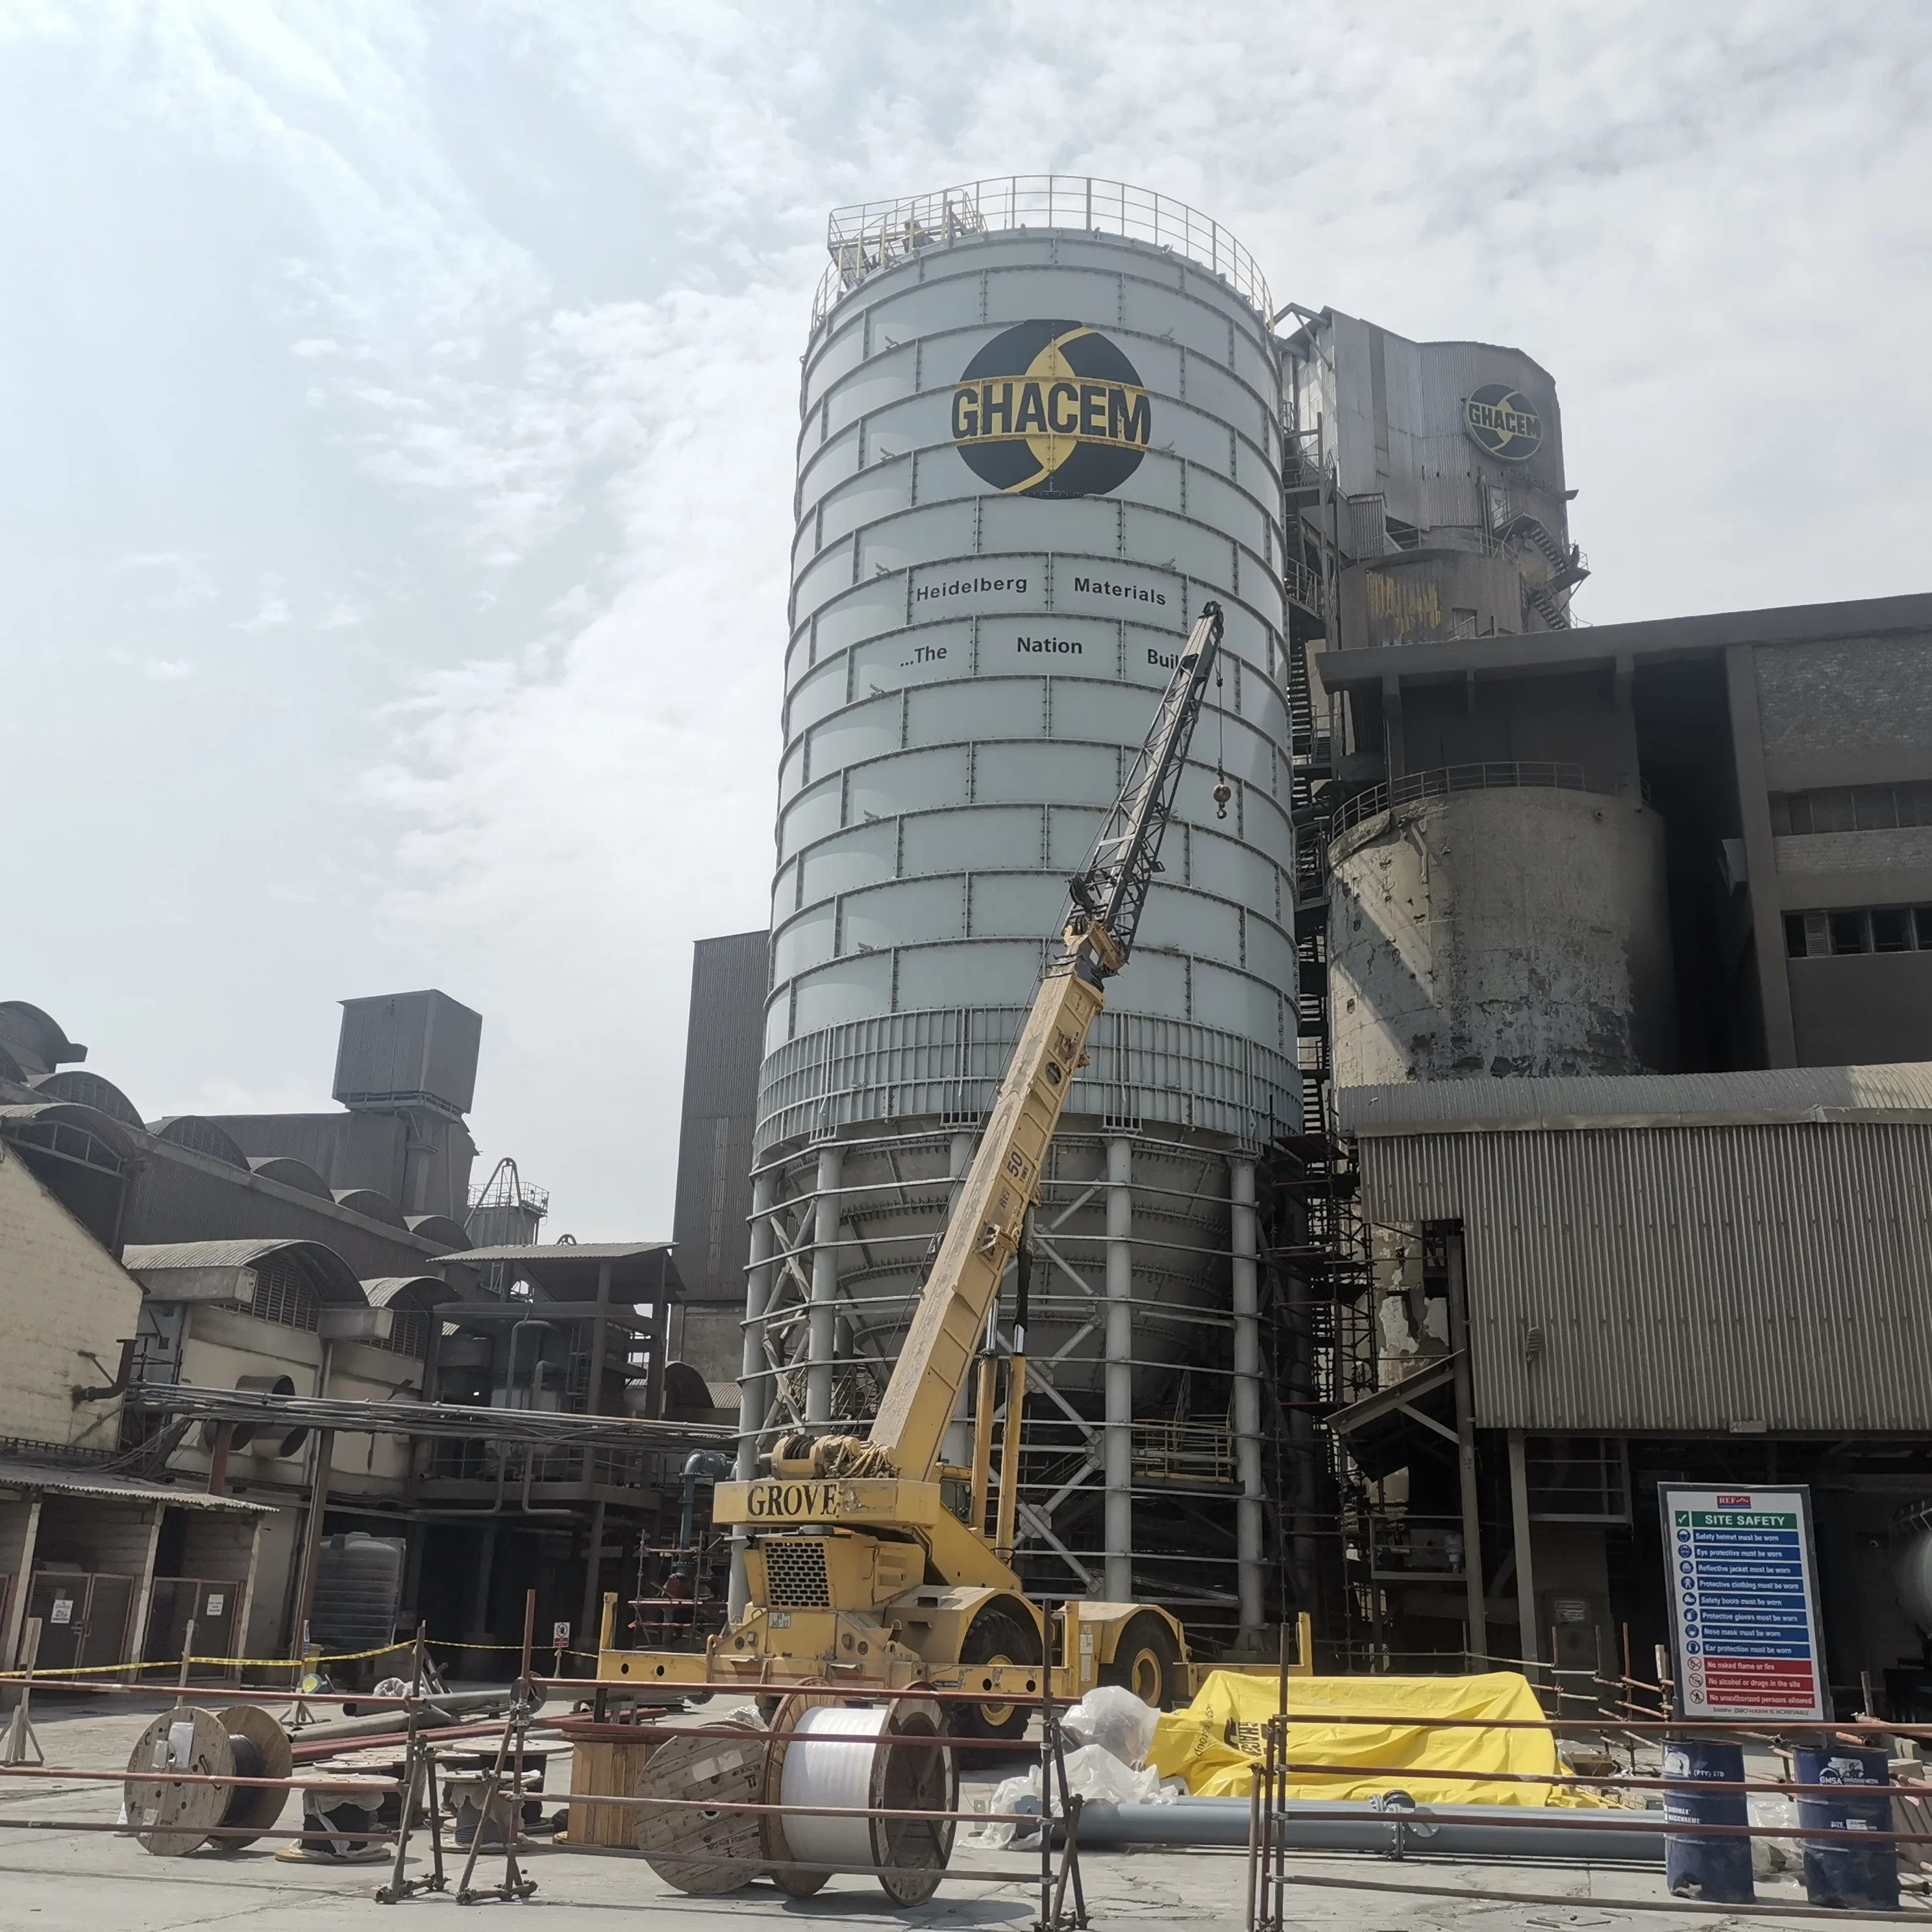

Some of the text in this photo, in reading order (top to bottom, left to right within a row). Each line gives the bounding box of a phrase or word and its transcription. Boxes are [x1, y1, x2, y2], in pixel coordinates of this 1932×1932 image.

[952, 383, 1151, 445] GHACEM
[1468, 403, 1542, 440] GHACEM
[917, 577, 1166, 606] Heidelberg Materials
[900, 636, 1179, 670] ...The Nation Buil
[1007, 1151, 1022, 1178] 50
[747, 1484, 837, 1516] GROVE
[1705, 1515, 1785, 1526] SITE SAFETY
[1696, 1533, 1715, 1541] Safety
[1729, 1565, 1748, 1574] jacket
[1731, 1581, 1756, 1590] clothing
[1694, 1770, 1711, 1778] (PTY)
[1819, 1776, 1842, 1785] GMSA
